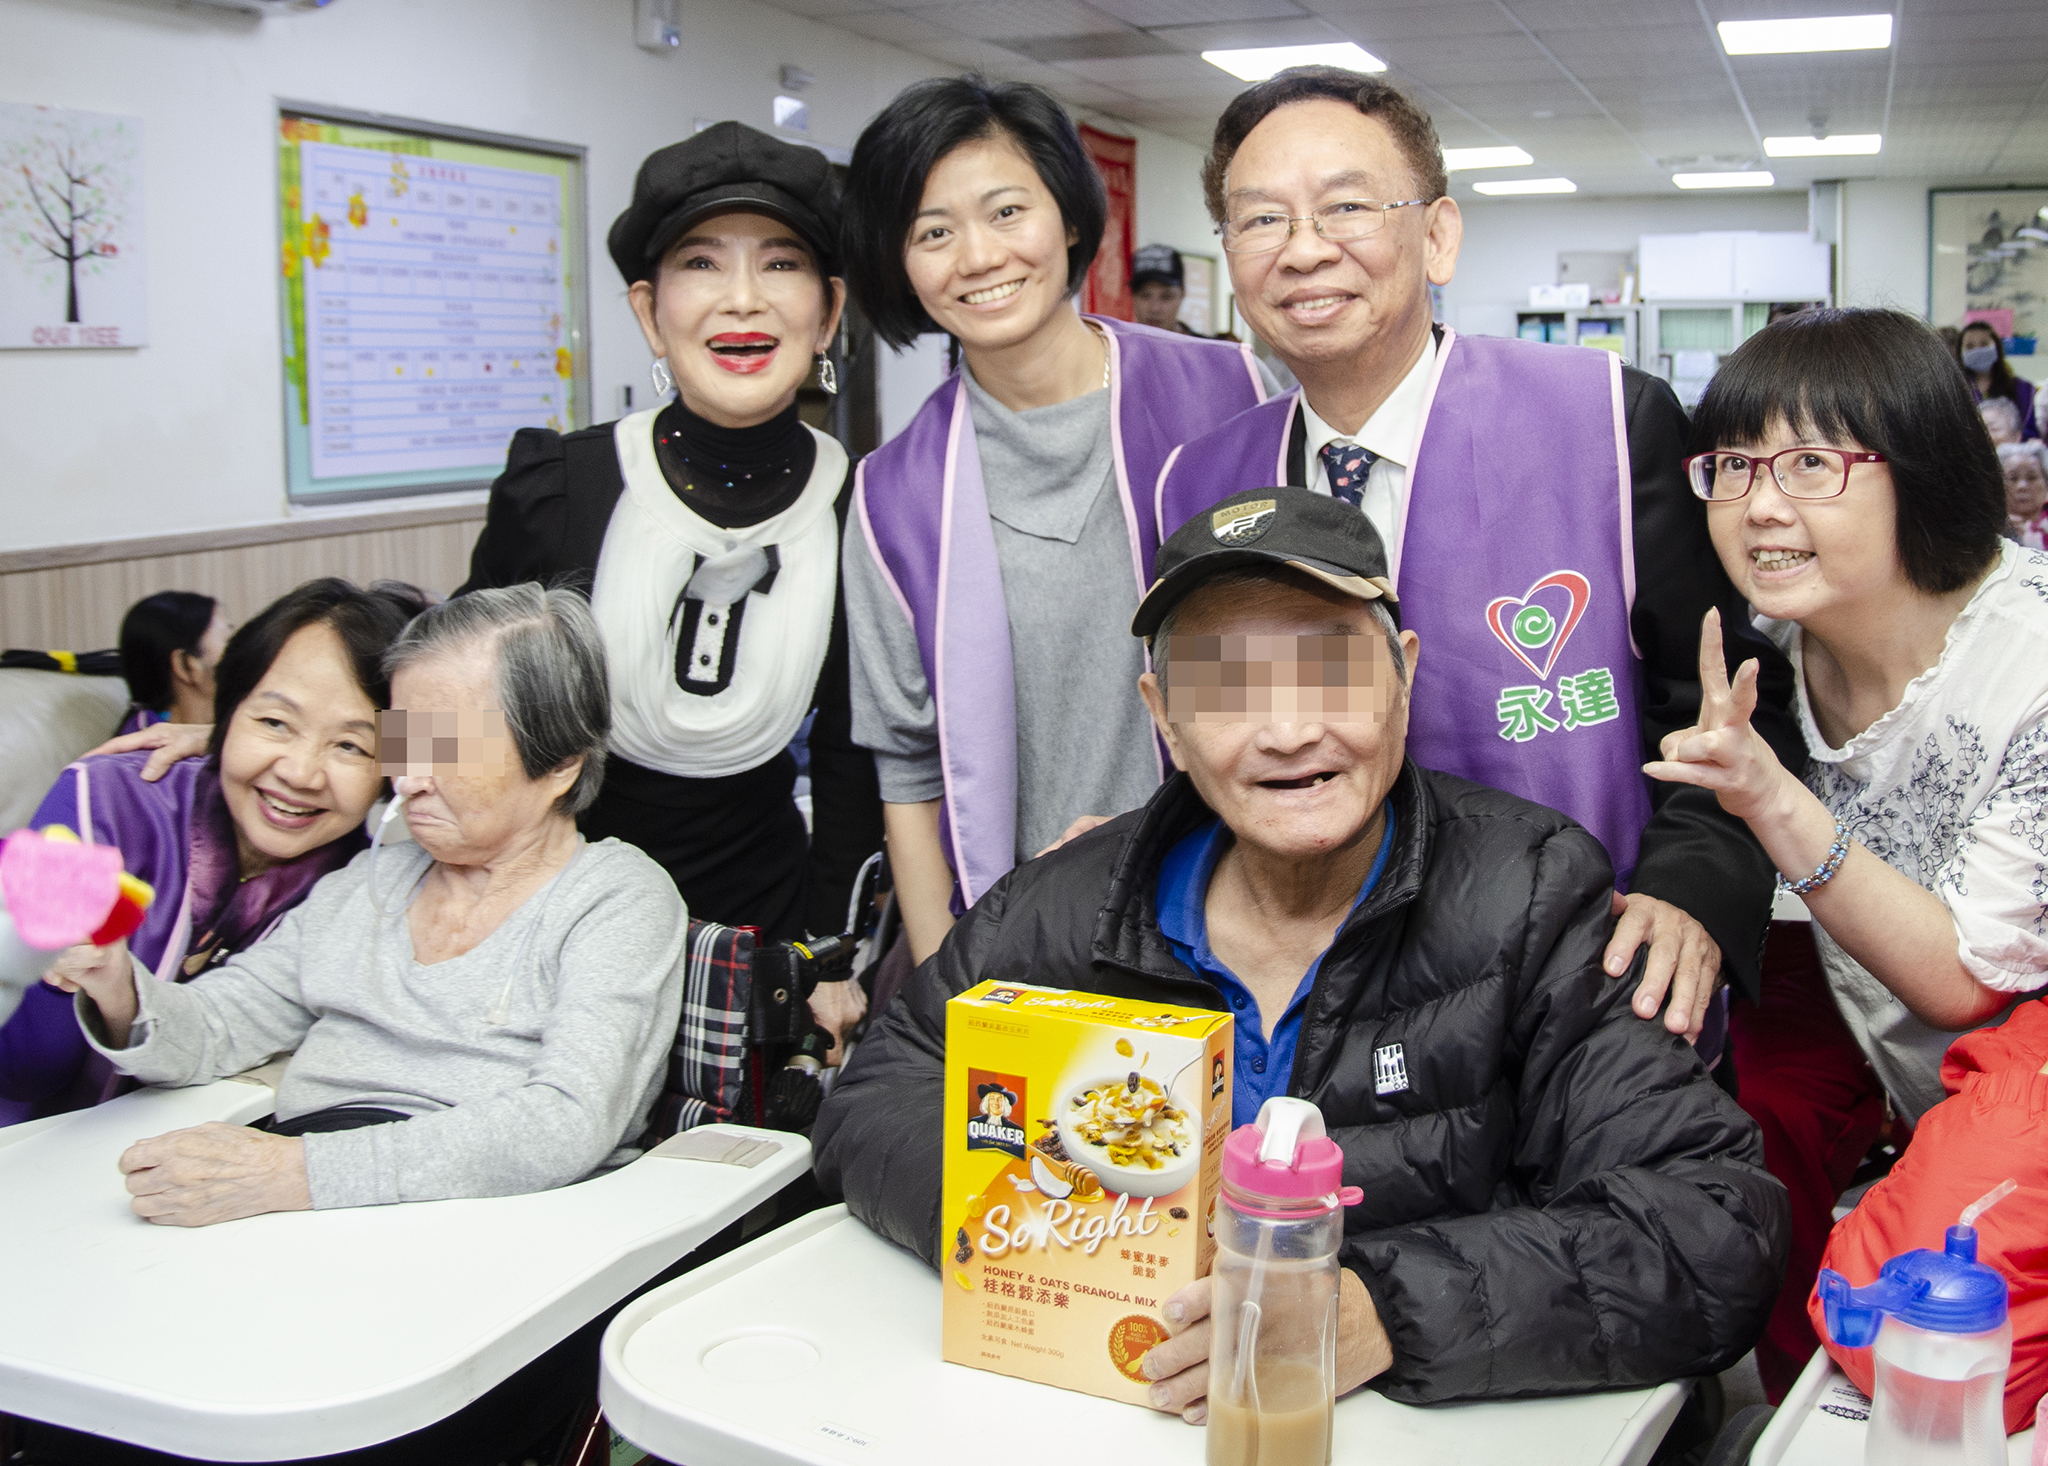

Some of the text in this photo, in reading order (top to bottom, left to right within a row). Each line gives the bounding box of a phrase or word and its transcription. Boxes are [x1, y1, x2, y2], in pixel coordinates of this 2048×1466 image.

[1220, 501, 1269, 518] MOTOR
[1497, 667, 1620, 742] 永達
[968, 1121, 1025, 1146] QUAKER
[1120, 1248, 1170, 1268] 蜂蜜果麥
[1132, 1264, 1157, 1280] 脆穀
[983, 1264, 1158, 1308] HONEY & OATS GRANOLA MIX
[983, 1277, 1070, 1310] 桂格穀添樂
[1129, 1321, 1149, 1335] 100%
[1010, 1340, 1023, 1349] Net
[1023, 1342, 1047, 1355] Weight
[1047, 1347, 1065, 1359] 300g
